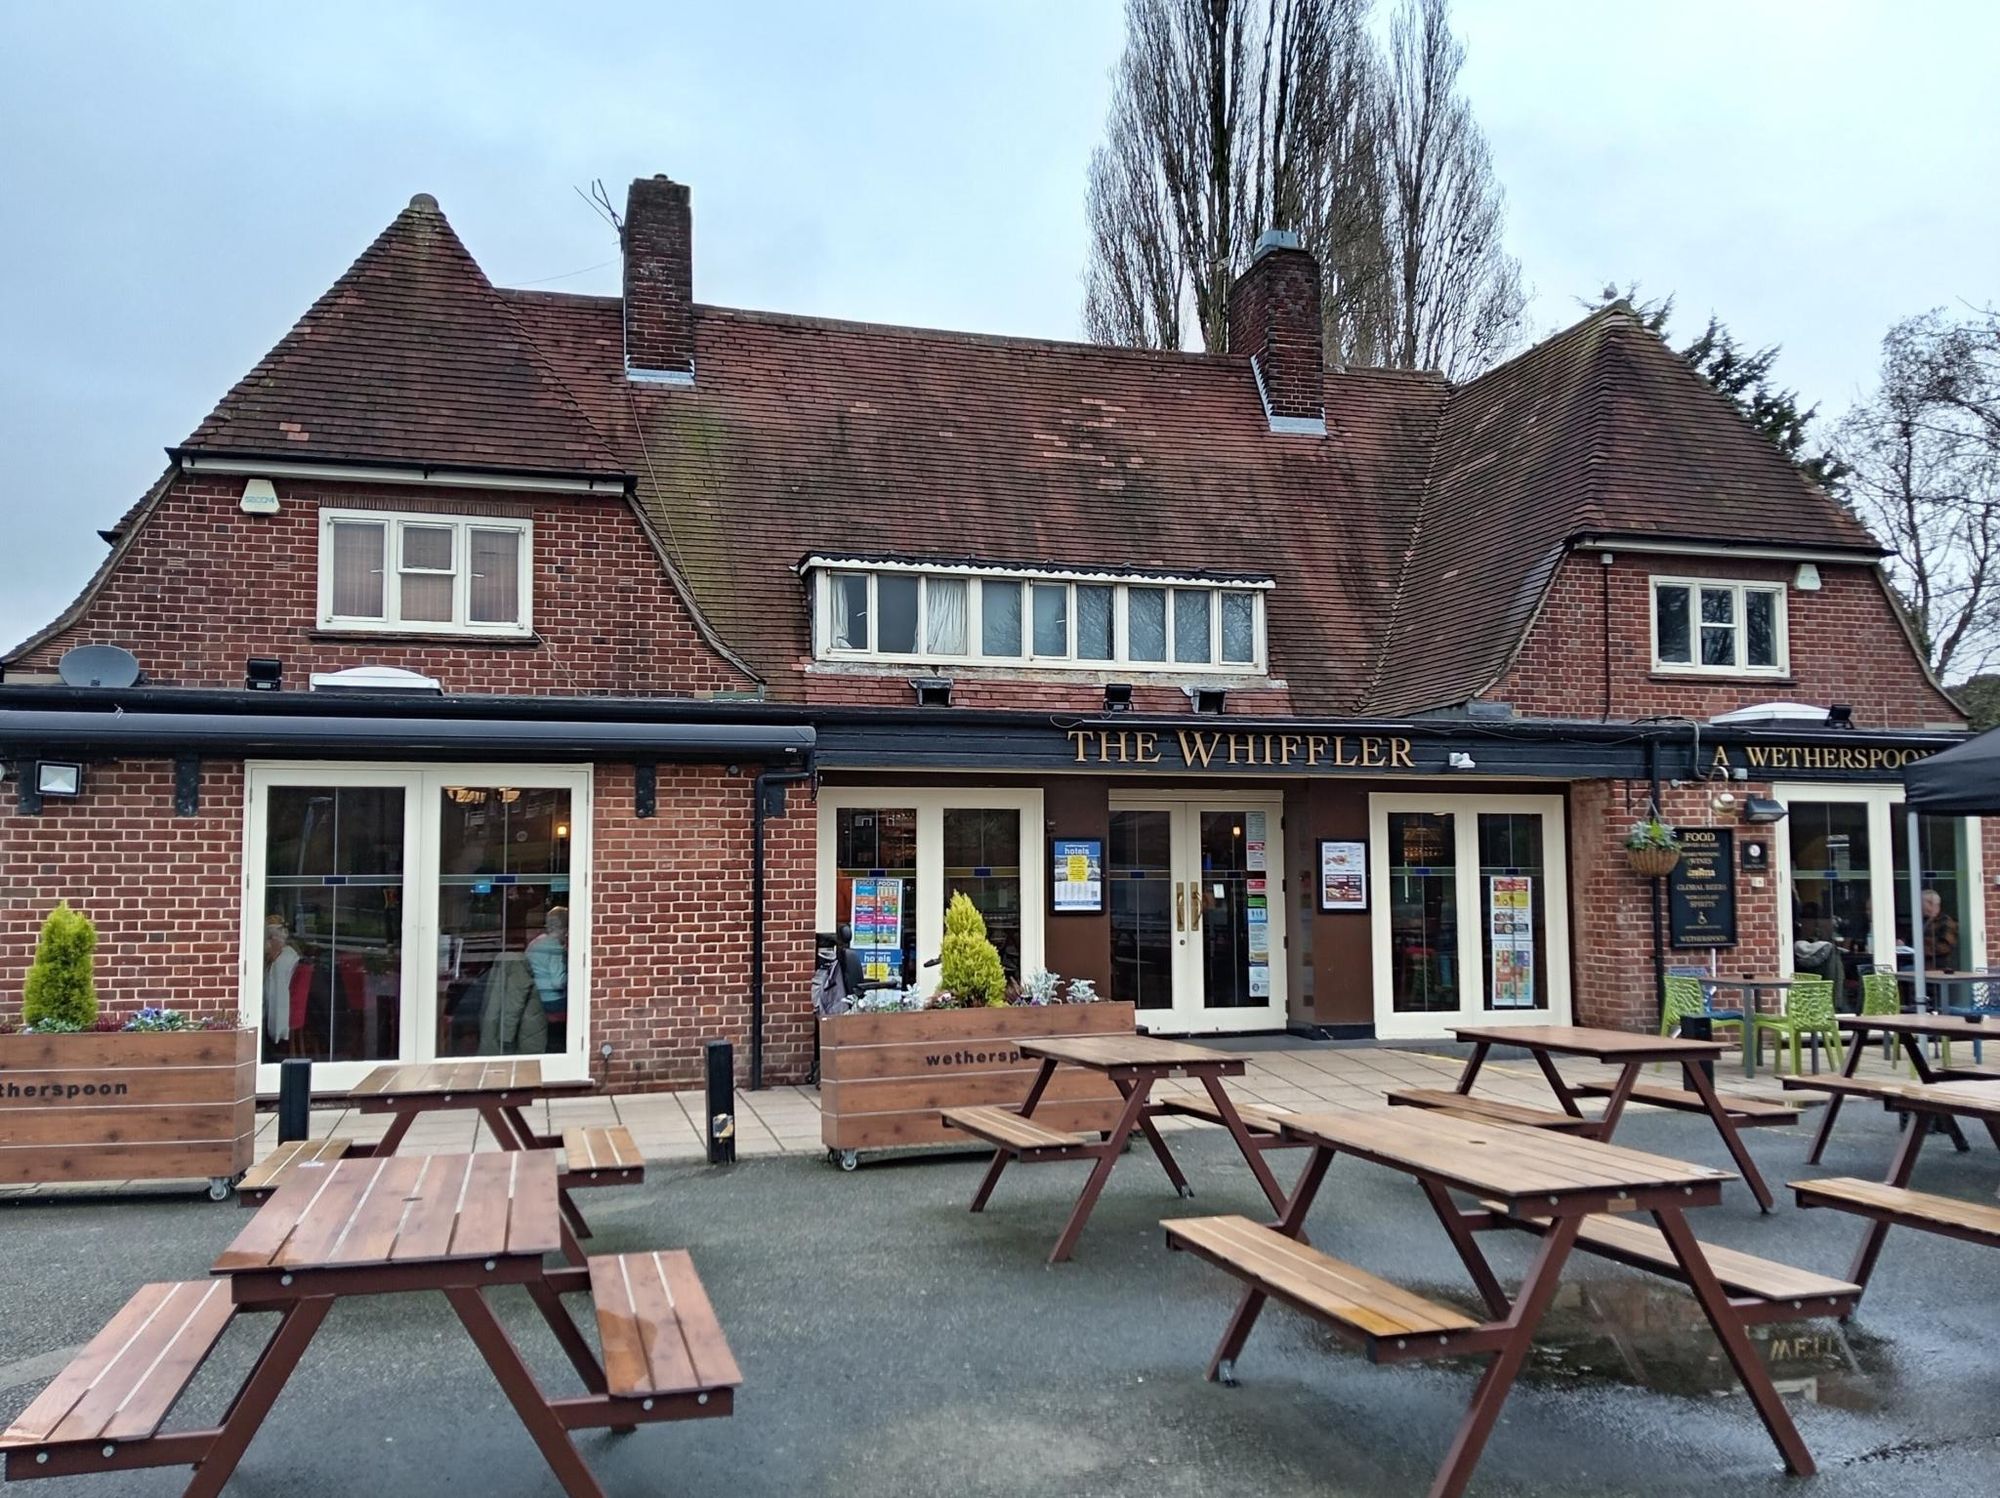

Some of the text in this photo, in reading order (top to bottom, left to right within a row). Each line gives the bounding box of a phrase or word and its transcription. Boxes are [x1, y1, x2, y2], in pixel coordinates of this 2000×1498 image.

[1068, 729, 1416, 768] THE WHIFFLER
[1712, 745, 1730, 766] A
[1685, 832, 1715, 842] FOOD
[1065, 847, 1090, 855] hotels
[926, 1050, 1043, 1067] wethersp
